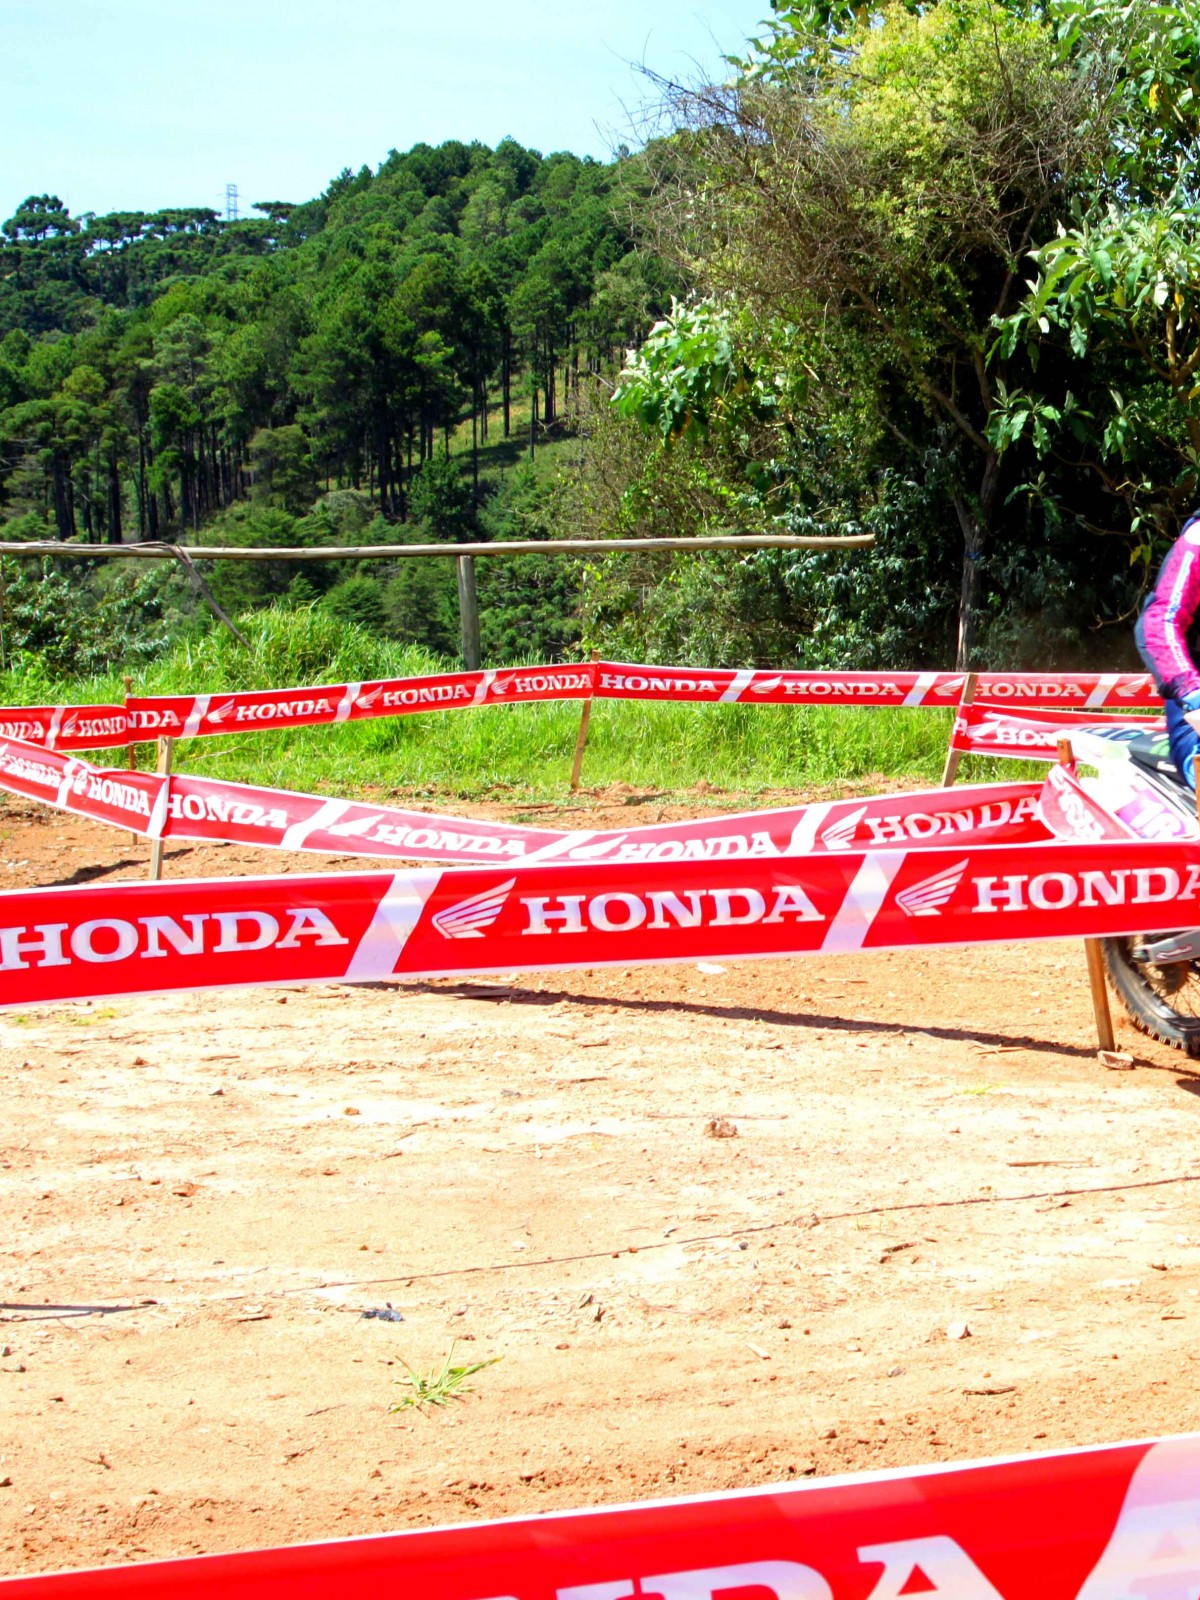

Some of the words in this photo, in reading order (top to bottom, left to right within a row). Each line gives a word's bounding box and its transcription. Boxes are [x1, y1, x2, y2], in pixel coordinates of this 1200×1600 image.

[383, 684, 473, 706] HONDA
[514, 673, 592, 693] HONDA
[600, 674, 720, 693] HONDA
[783, 681, 904, 697] HONDA
[974, 683, 1086, 697] HONDA
[236, 698, 334, 721] HONDA
[0, 721, 44, 739] NDA
[88, 775, 150, 816] HONDA
[168, 793, 287, 828] HONDA
[864, 797, 1040, 845] HONDA
[374, 823, 526, 856] HONDA
[616, 831, 778, 858] HONDA
[520, 885, 825, 936] HONDA
[0, 907, 349, 970] HONDA
